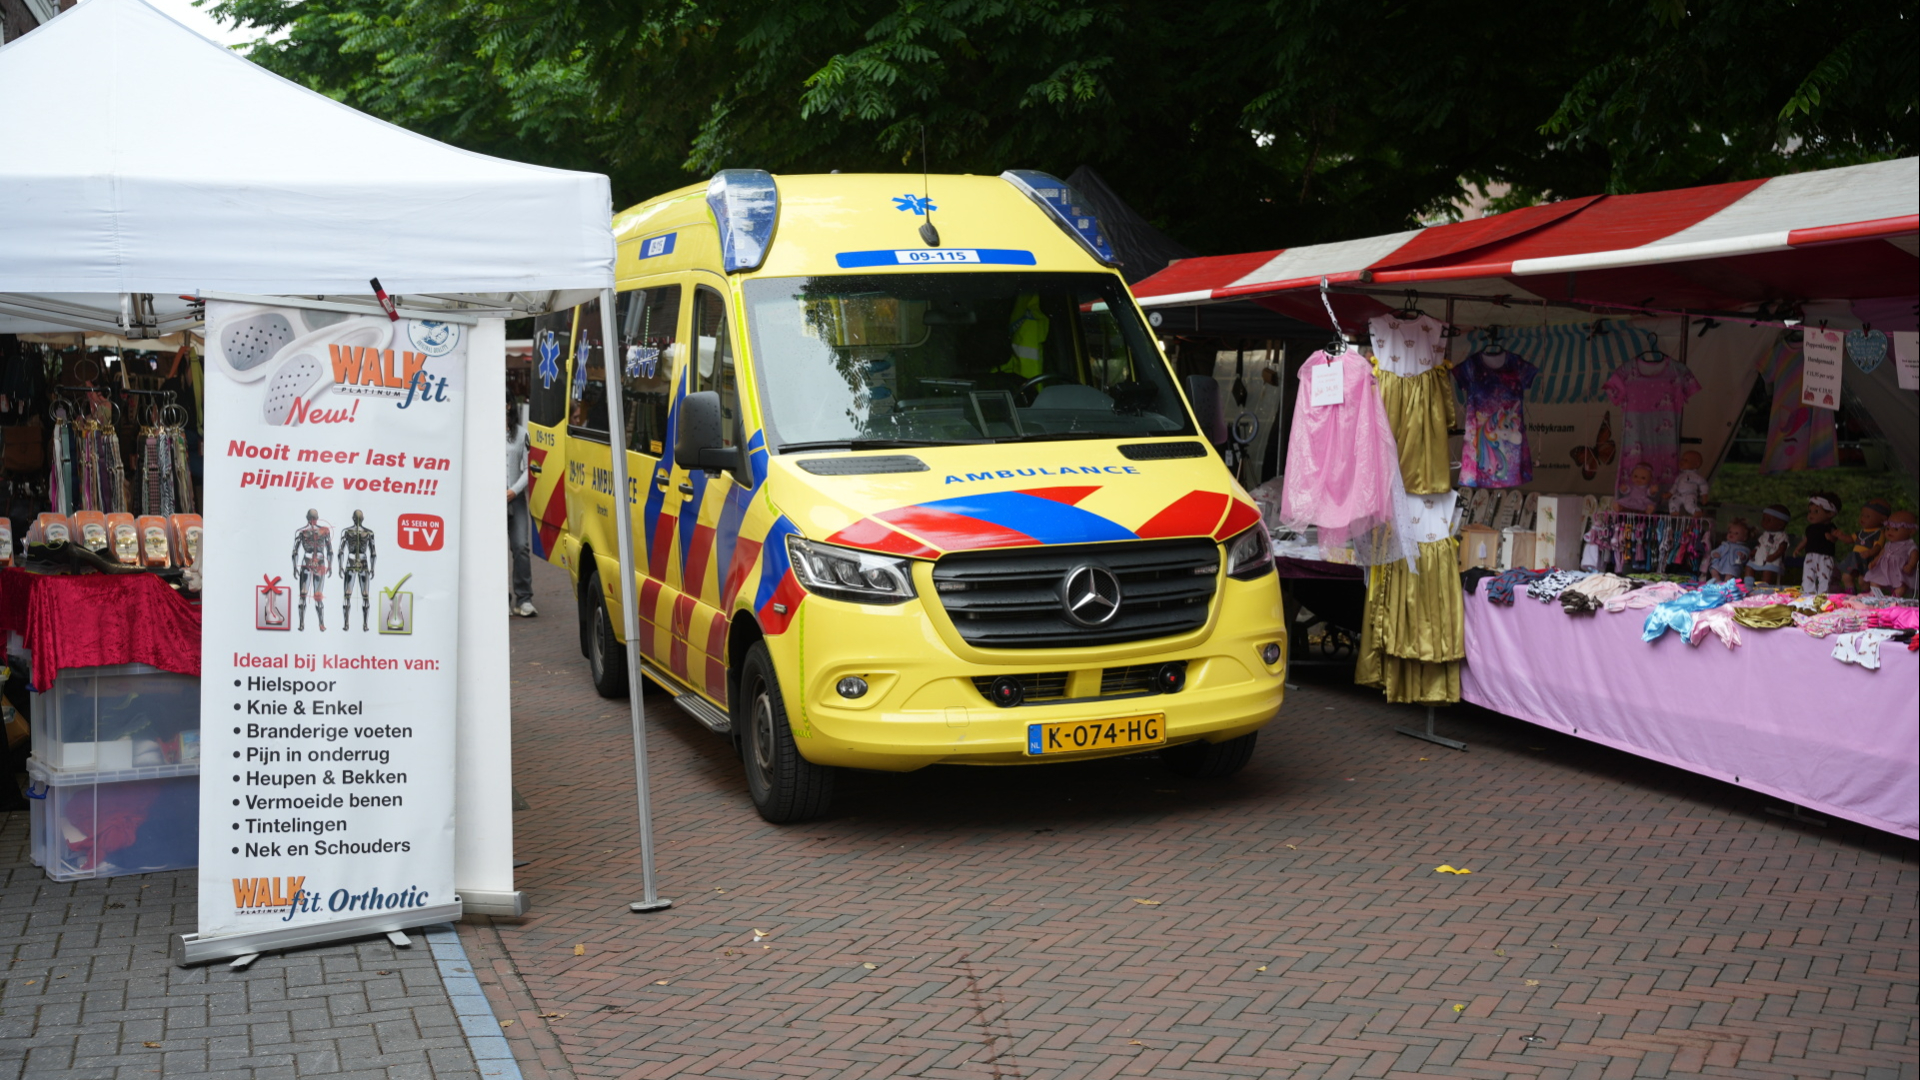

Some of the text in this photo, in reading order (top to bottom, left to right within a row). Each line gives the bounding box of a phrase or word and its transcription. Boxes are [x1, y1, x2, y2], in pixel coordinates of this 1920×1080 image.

[908, 251, 967, 262] 09-115
[328, 343, 450, 410] WALK fit
[341, 387, 401, 397] PLATINUM
[284, 396, 360, 425] New!
[1528, 422, 1575, 435] Hobbykraam
[536, 430, 555, 447] 09-115
[227, 440, 451, 471] Nooit meer last van
[240, 469, 438, 496] pijnlijke voeten!!!
[945, 466, 1141, 485] AMBULANCE
[401, 519, 440, 529] AS SEEN ON
[403, 527, 439, 547] TV
[233, 653, 440, 672] Ideaal bij klachten van:
[247, 676, 337, 695] Hielspoor
[247, 700, 363, 716] Knie & Enkel
[246, 722, 413, 742] Branderige voeten
[1048, 718, 1159, 749] K-074-HG
[1030, 741, 1041, 749] NL
[246, 746, 390, 765] Pijn in onderrug
[246, 769, 408, 788] Heupen & Bekken
[246, 792, 403, 810] Vermoeide benen
[245, 817, 347, 835] Tintelingen
[245, 838, 411, 858] Nek en Schouders
[232, 875, 429, 922] WALK fit Orthotic
